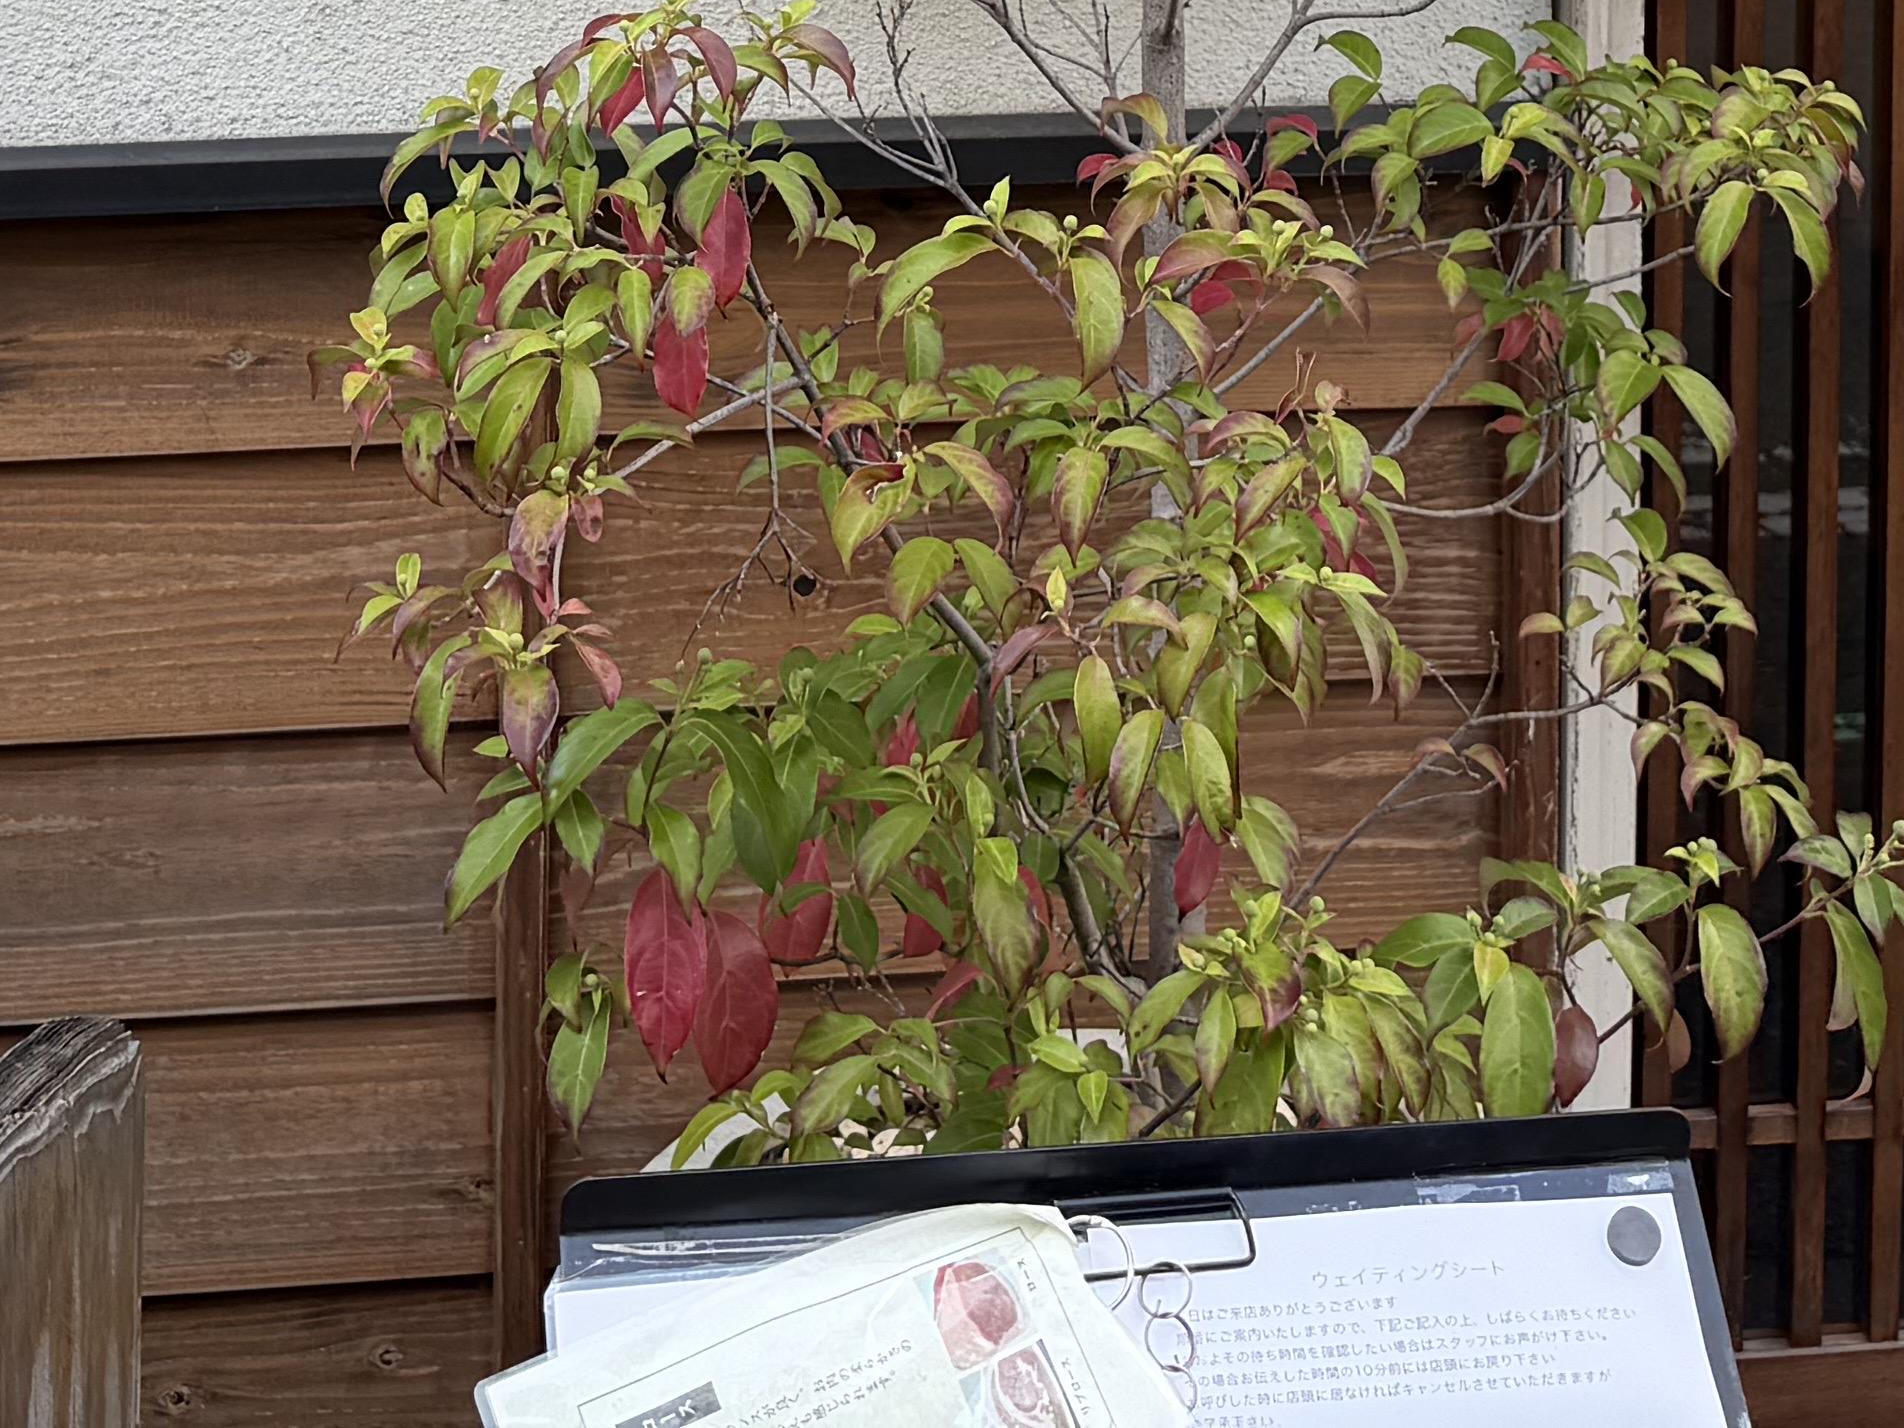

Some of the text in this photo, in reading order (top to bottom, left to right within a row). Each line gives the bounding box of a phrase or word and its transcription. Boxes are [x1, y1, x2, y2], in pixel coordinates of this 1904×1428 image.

[1311, 1259, 1505, 1290] ウェイティングシート
